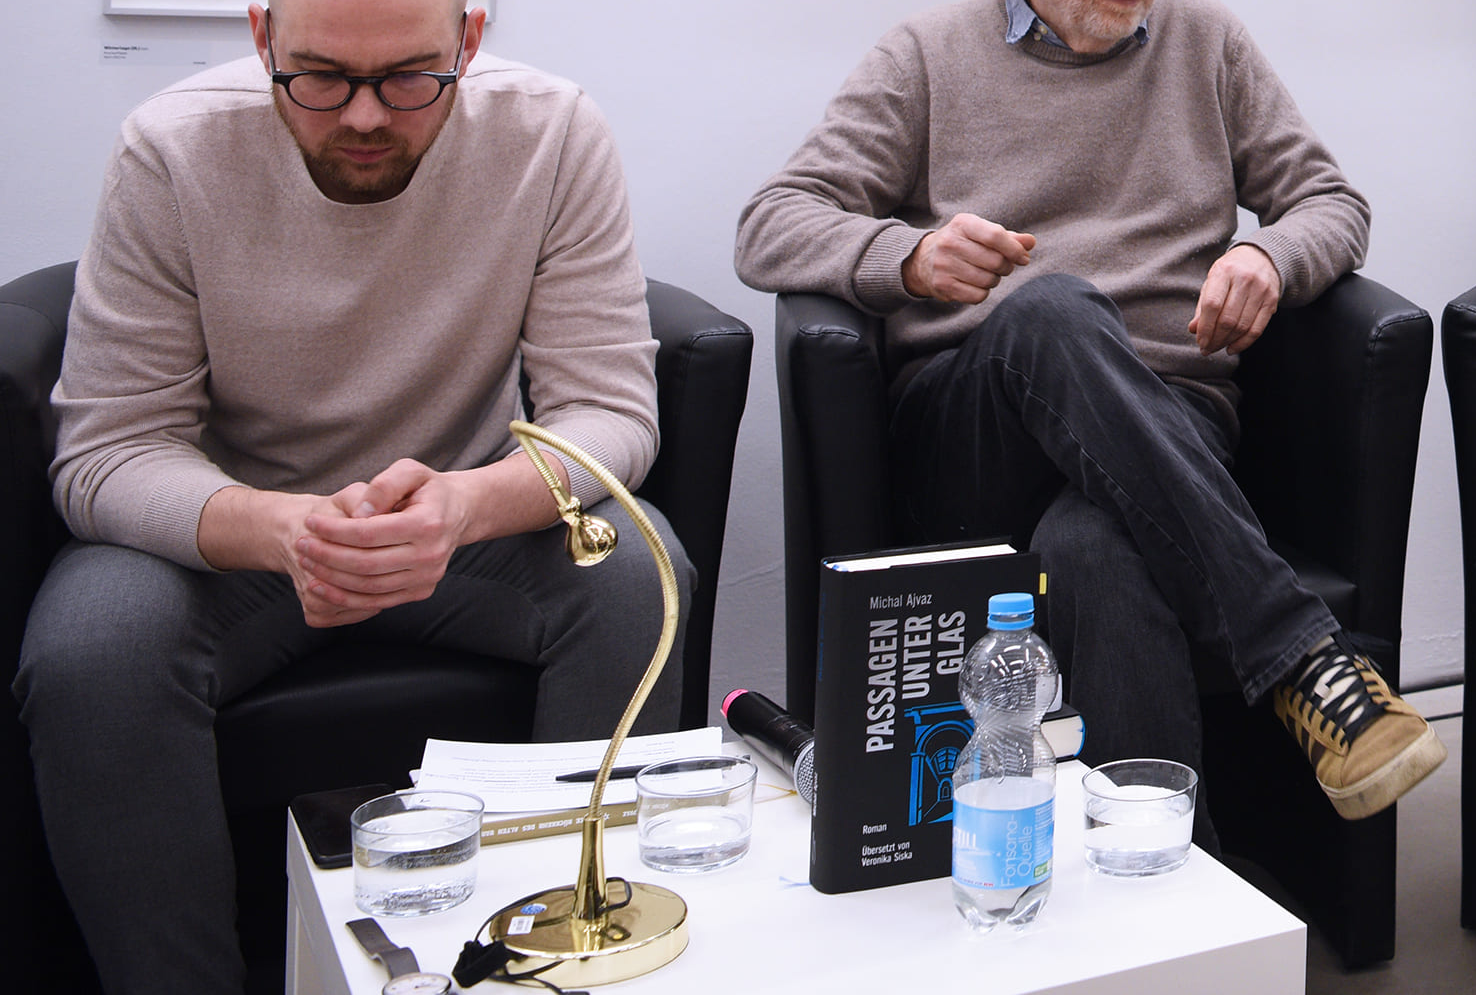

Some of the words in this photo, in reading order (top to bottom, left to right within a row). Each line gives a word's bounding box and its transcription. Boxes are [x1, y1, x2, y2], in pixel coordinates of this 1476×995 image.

[869, 594, 903, 610] Michal
[906, 593, 933, 608] Ajvaz
[901, 614, 933, 700] UNTER
[935, 610, 966, 676] GLAS
[865, 618, 898, 752] PASSAGEN
[862, 823, 887, 835] Roman
[861, 843, 896, 856] Übersetzt
[897, 841, 910, 851] von
[861, 854, 892, 867] Veronika
[894, 851, 913, 862] Siska
[1016, 825, 1034, 877] Quelle
